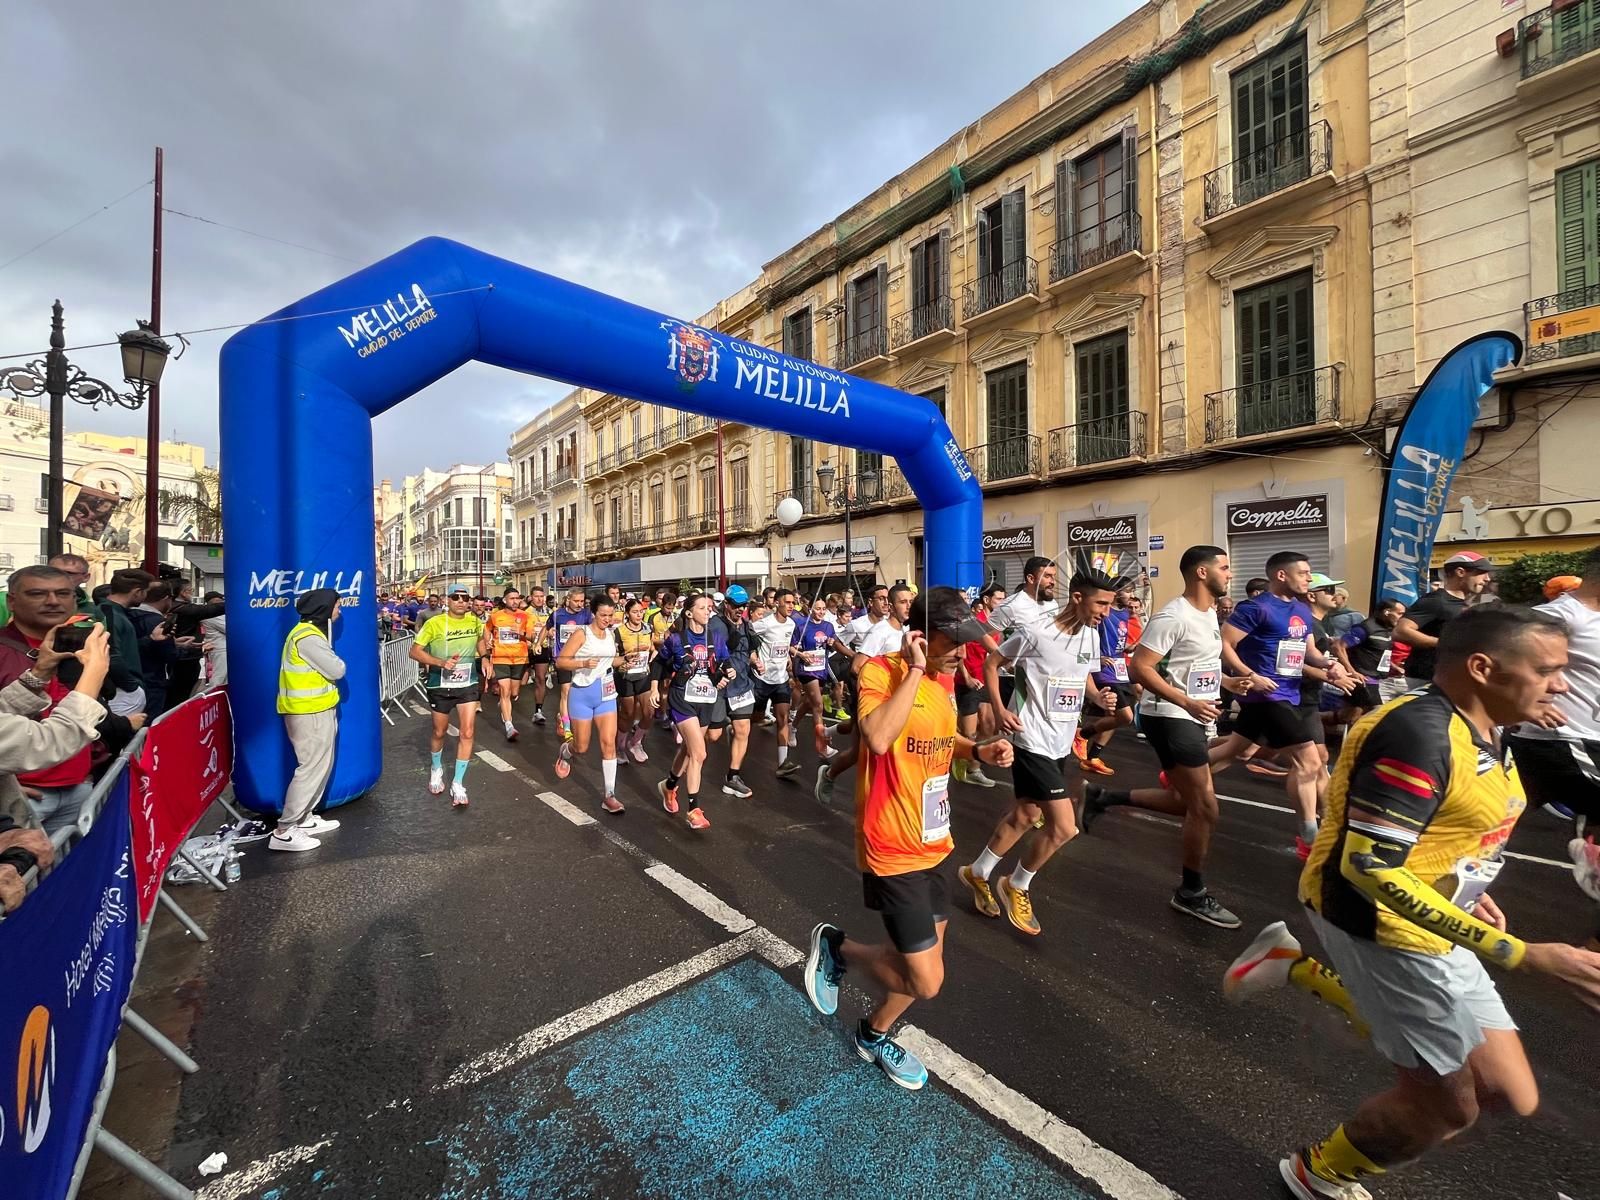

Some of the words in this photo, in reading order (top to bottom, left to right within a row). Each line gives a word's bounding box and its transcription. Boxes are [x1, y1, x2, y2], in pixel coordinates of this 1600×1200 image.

[337, 283, 432, 348] MELILLA
[357, 335, 388, 358] CIUDAD
[388, 327, 406, 341] DEL
[404, 307, 438, 332] DEPORTE
[730, 341, 779, 364] CIUDAD
[745, 359, 755, 368] DE
[734, 356, 850, 418] MELILLA
[946, 438, 972, 481] MELILLA
[1230, 500, 1324, 528] Coppelia
[1509, 507, 1573, 537] YO
[982, 530, 1033, 550] Coppelia
[1069, 519, 1134, 542] Coppelia
[249, 596, 290, 608] CIUDAD
[1196, 676, 1216, 688] 334
[1058, 694, 1077, 706] 331
[1377, 880, 1489, 943] AFRICANUS
